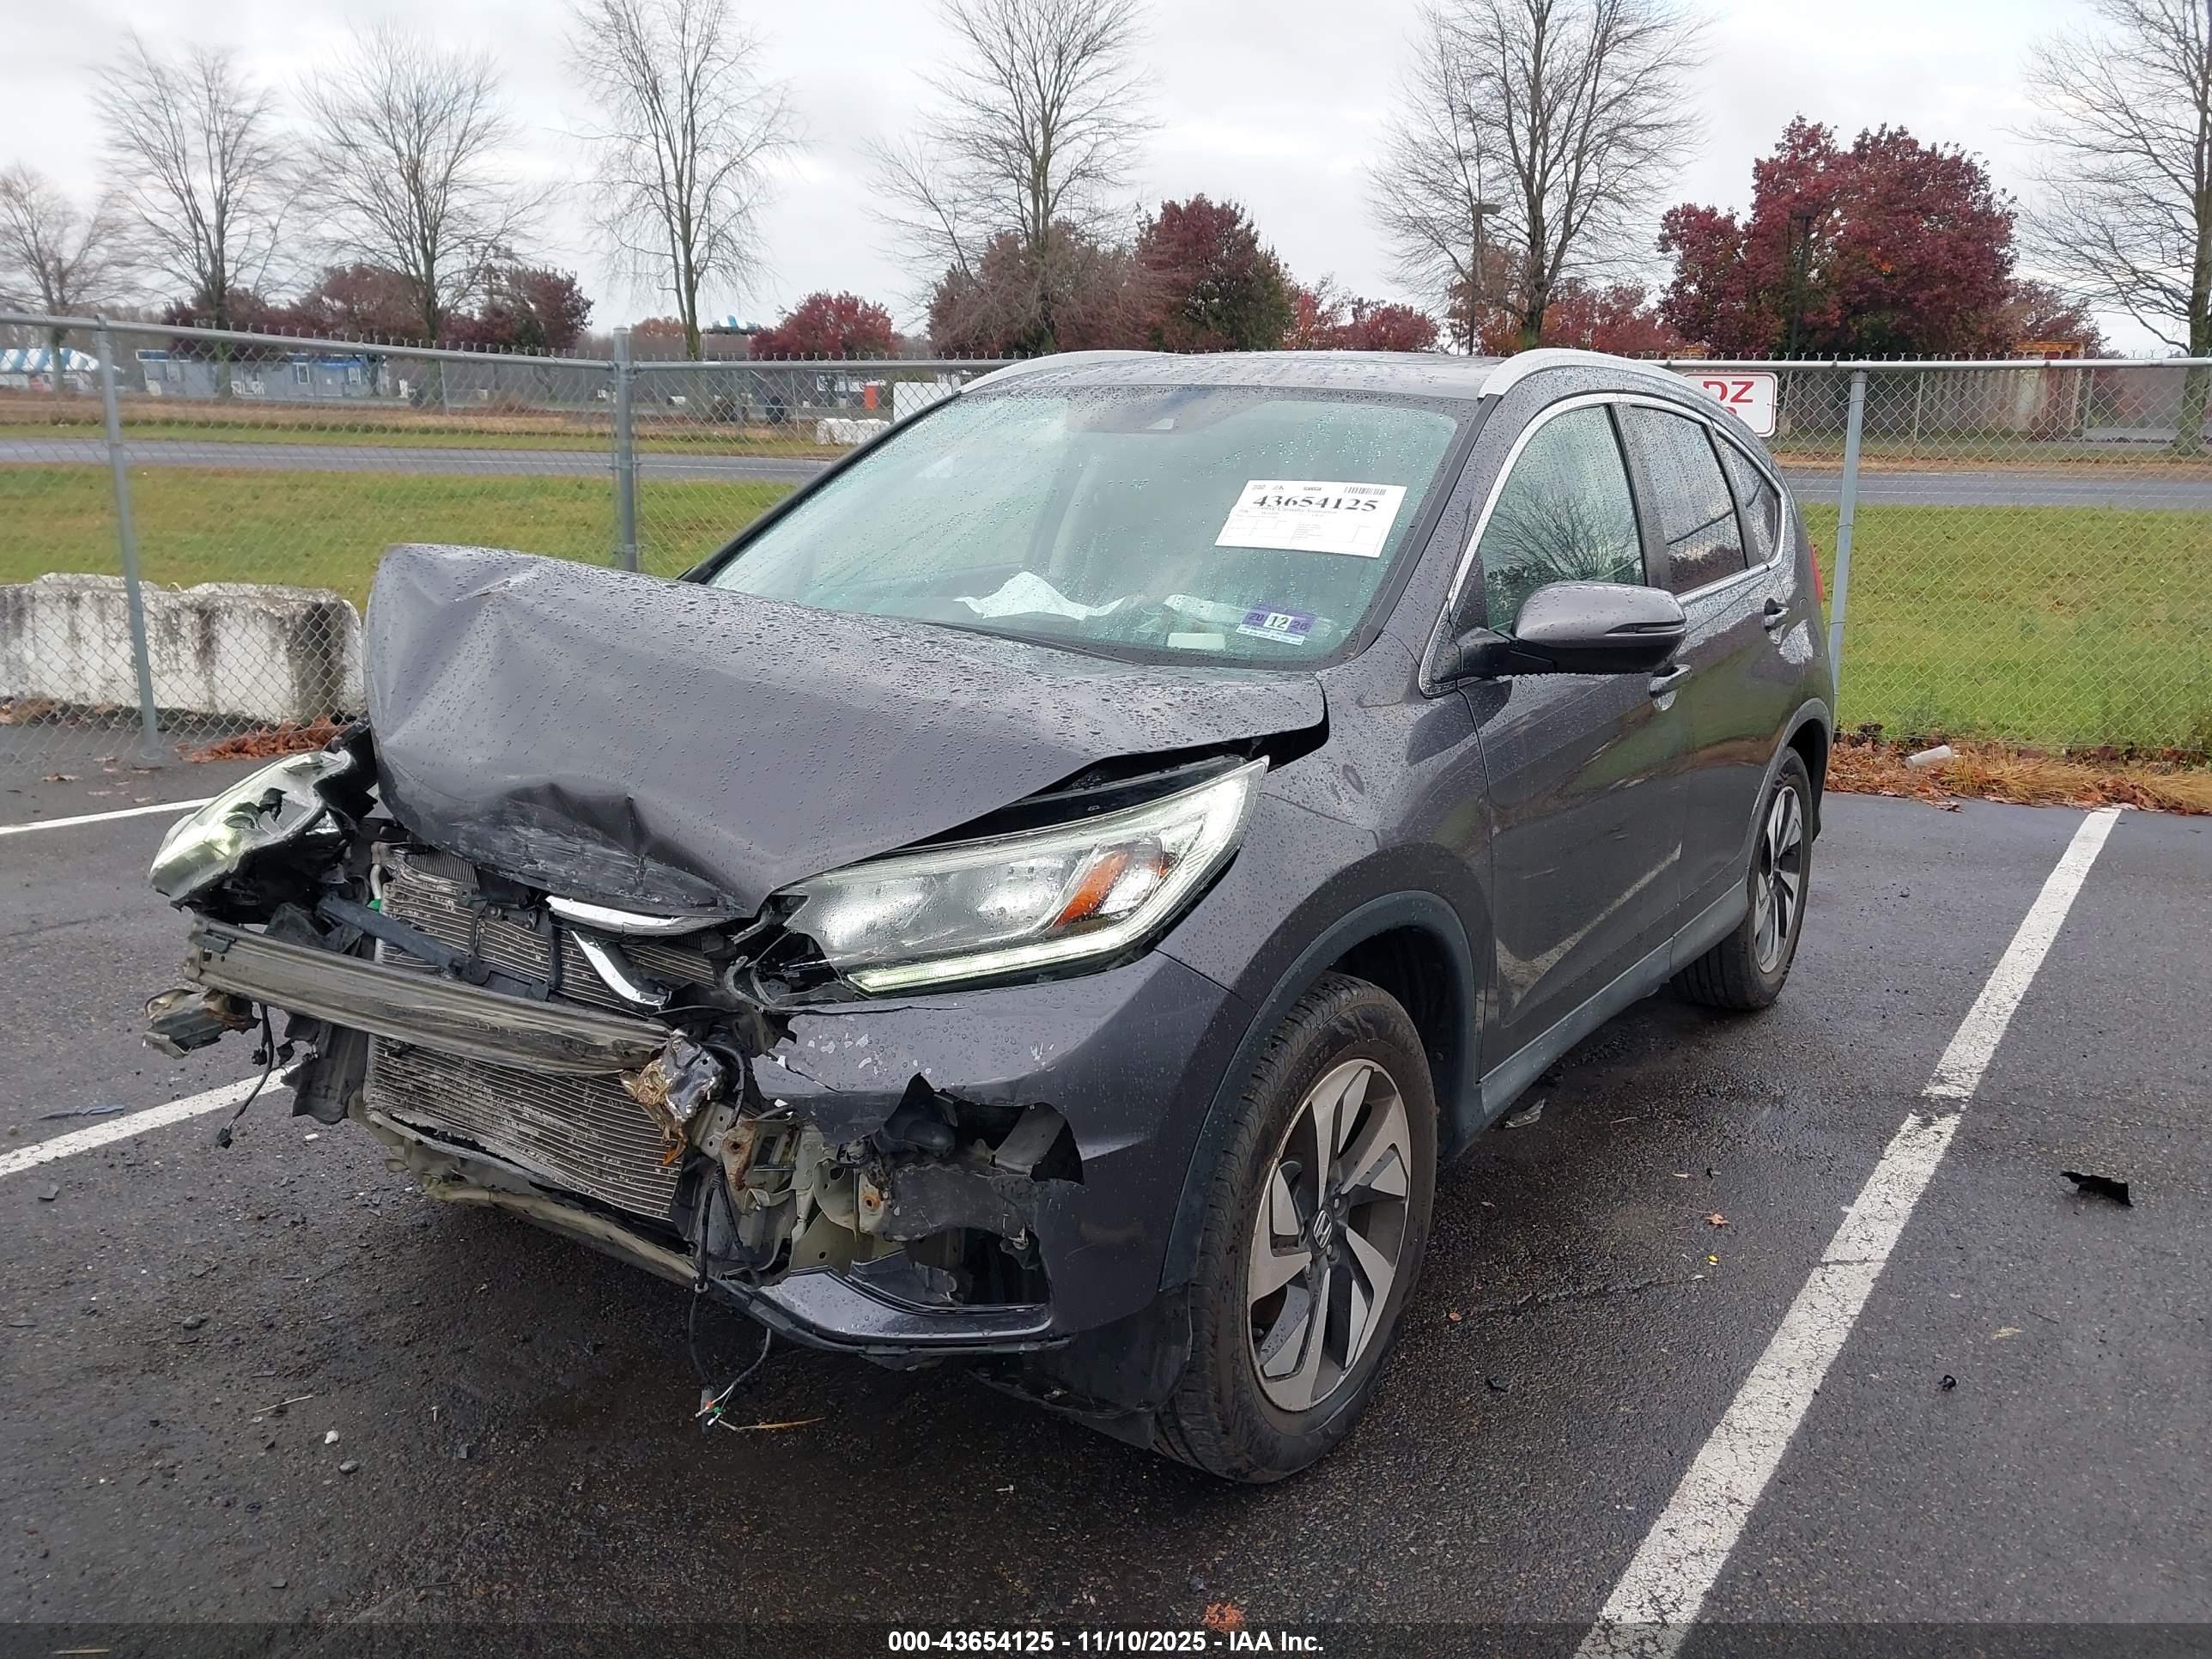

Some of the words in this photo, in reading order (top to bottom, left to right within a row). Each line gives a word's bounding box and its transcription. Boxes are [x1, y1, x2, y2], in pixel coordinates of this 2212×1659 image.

[1252, 495, 1380, 512] 43654125
[1249, 612, 1265, 622] 20
[1268, 616, 1289, 629] 12
[1291, 621, 1310, 630] 26
